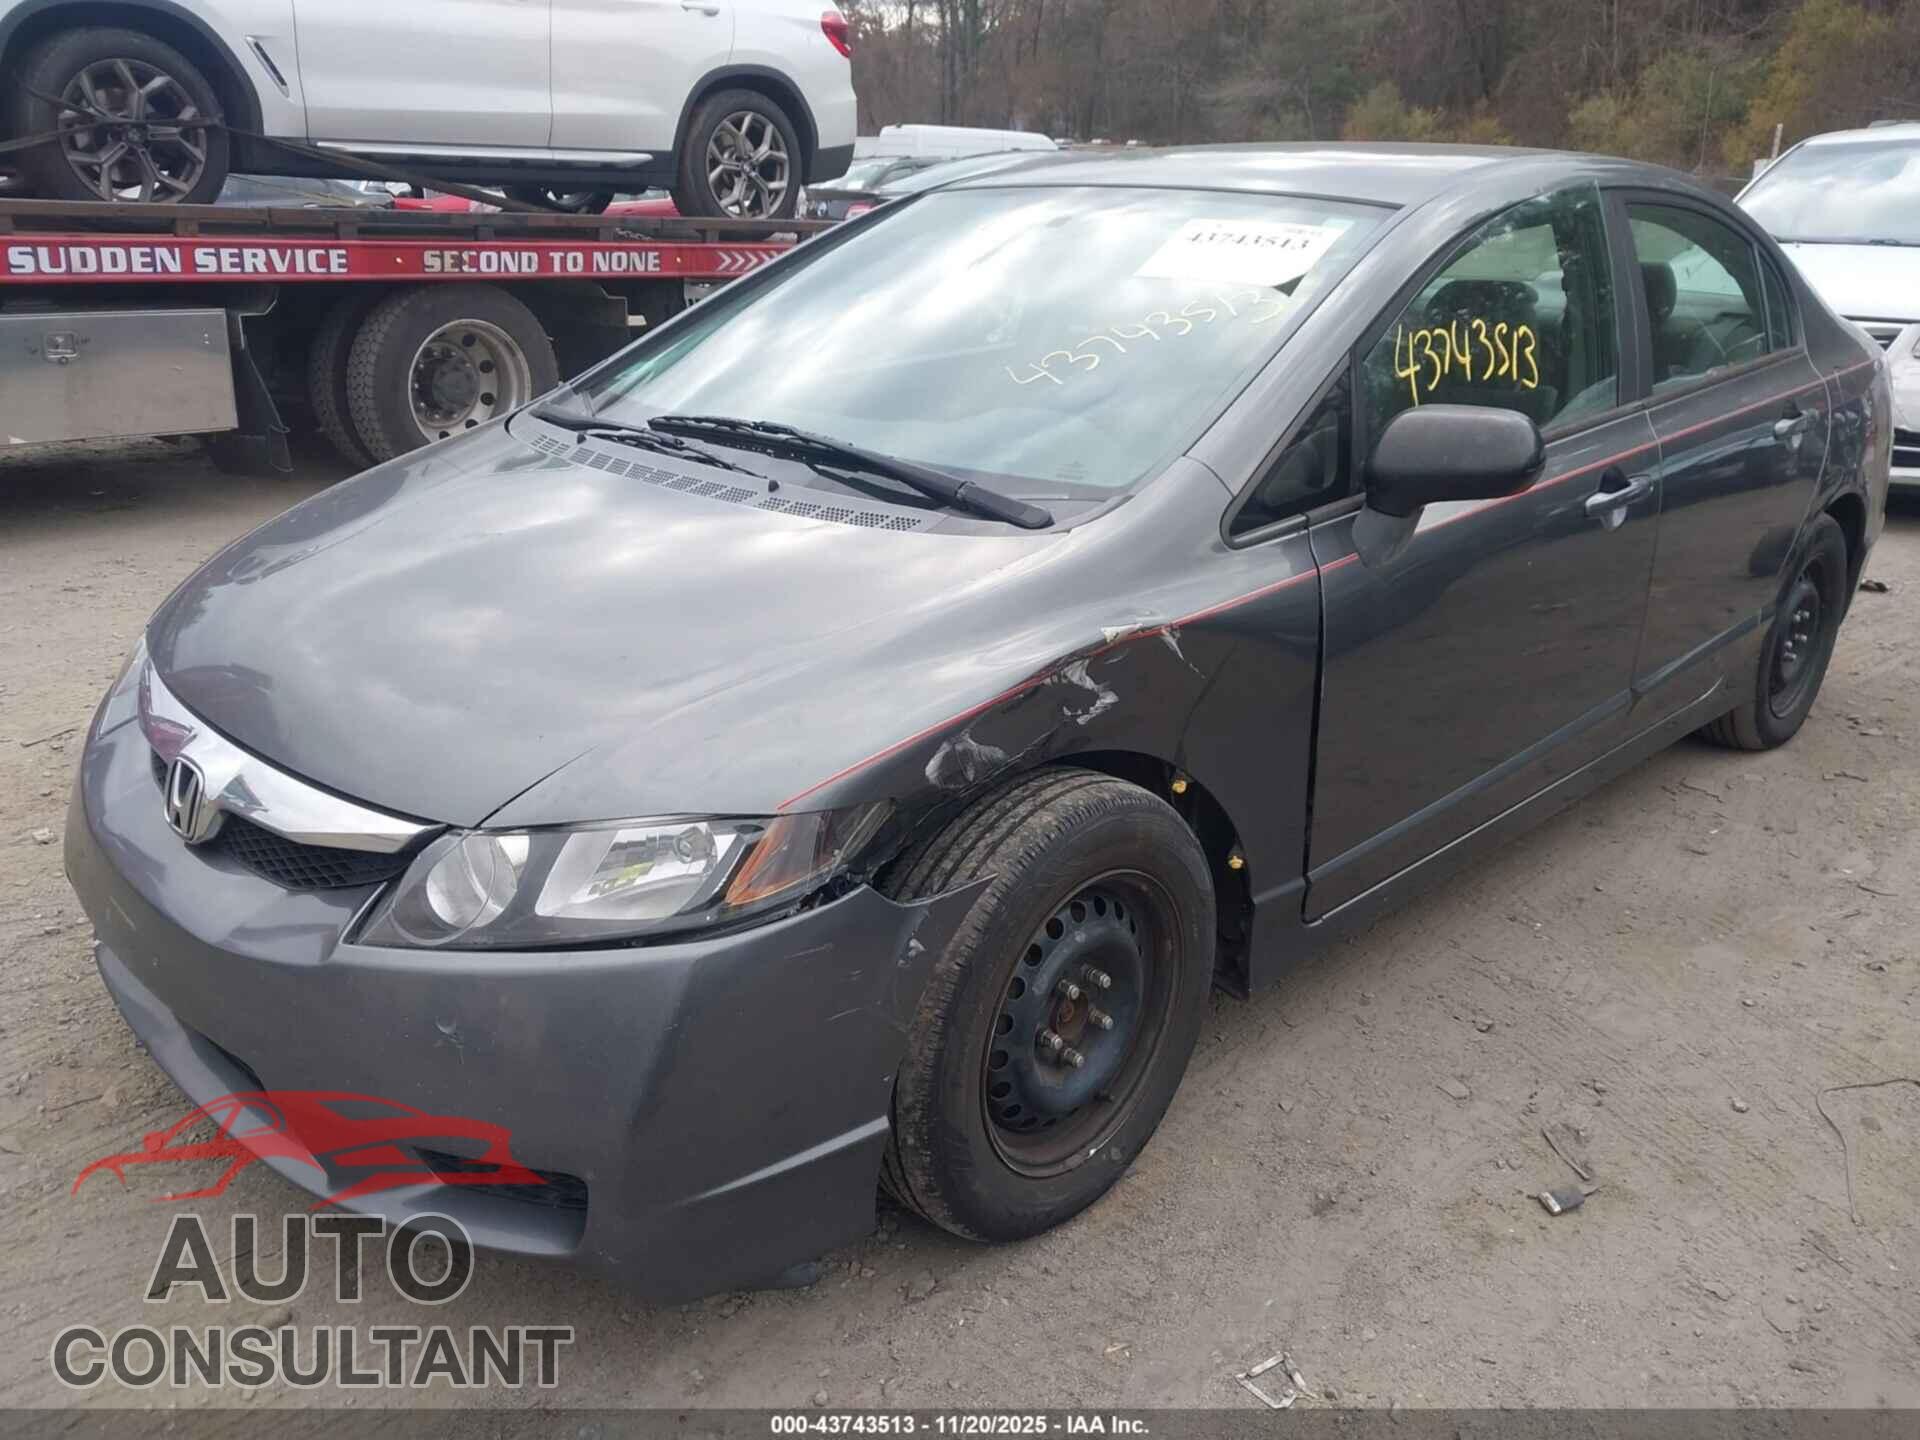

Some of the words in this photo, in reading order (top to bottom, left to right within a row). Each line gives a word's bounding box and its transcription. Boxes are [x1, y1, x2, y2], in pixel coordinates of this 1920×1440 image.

[7, 246, 182, 274] SUDDEN
[194, 248, 349, 274] SERVICE
[423, 250, 538, 273] SECOND
[549, 252, 584, 273] TO
[592, 252, 661, 273] NONE
